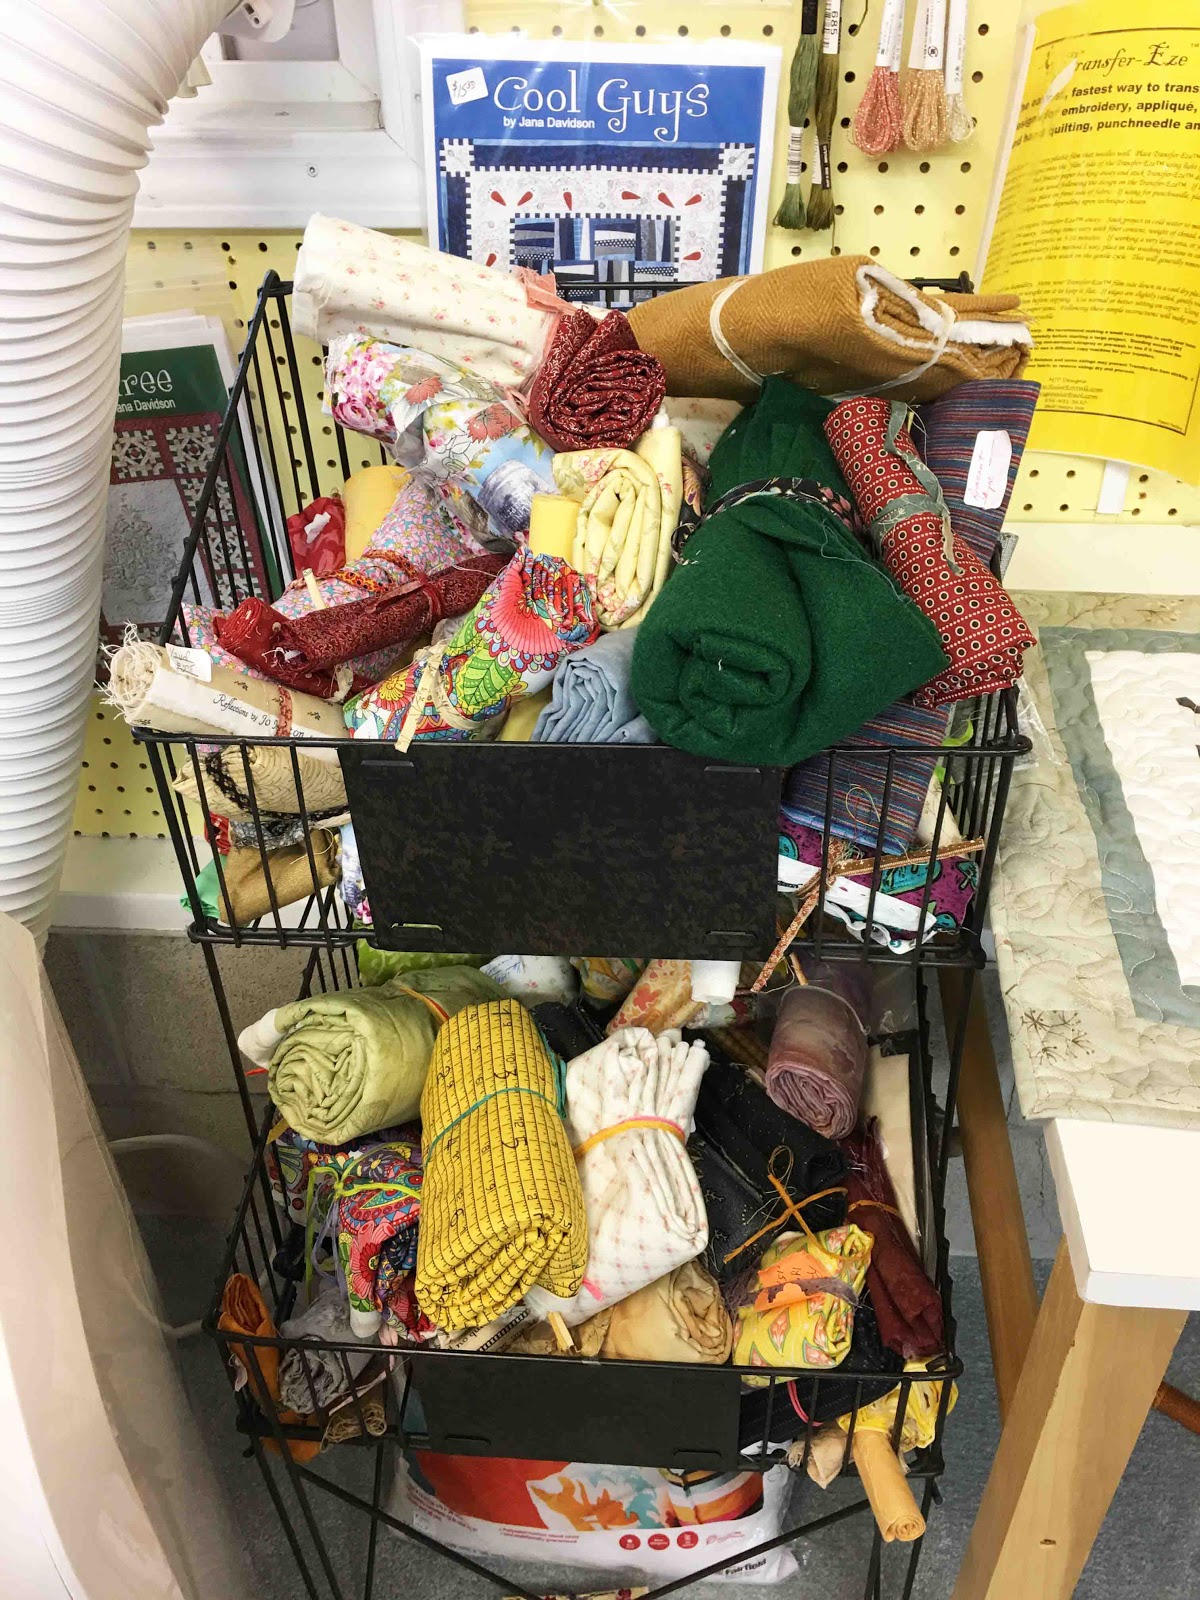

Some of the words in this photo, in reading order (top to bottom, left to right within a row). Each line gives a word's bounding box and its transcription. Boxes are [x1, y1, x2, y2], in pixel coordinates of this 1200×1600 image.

[830, 10, 839, 35] 685
[1071, 84, 1113, 98] fastest
[1116, 82, 1143, 95] way
[1146, 82, 1160, 93] to
[1164, 82, 1200, 94] trans
[493, 69, 582, 114] Cool
[596, 78, 711, 144] Guys
[1061, 101, 1133, 117] embroidery,
[1136, 99, 1198, 114] appliqué,
[503, 116, 517, 129] by
[518, 115, 545, 129] Jana
[546, 116, 596, 130] Davidson
[1048, 119, 1093, 138] quilting,
[1097, 118, 1182, 132] punchneedle
[119, 368, 174, 397] ree
[116, 401, 133, 413] ana
[134, 398, 176, 412] Davidson
[213, 693, 249, 718] Reflections
[250, 713, 258, 722] by
[725, 1558, 767, 1575] Fairfield
